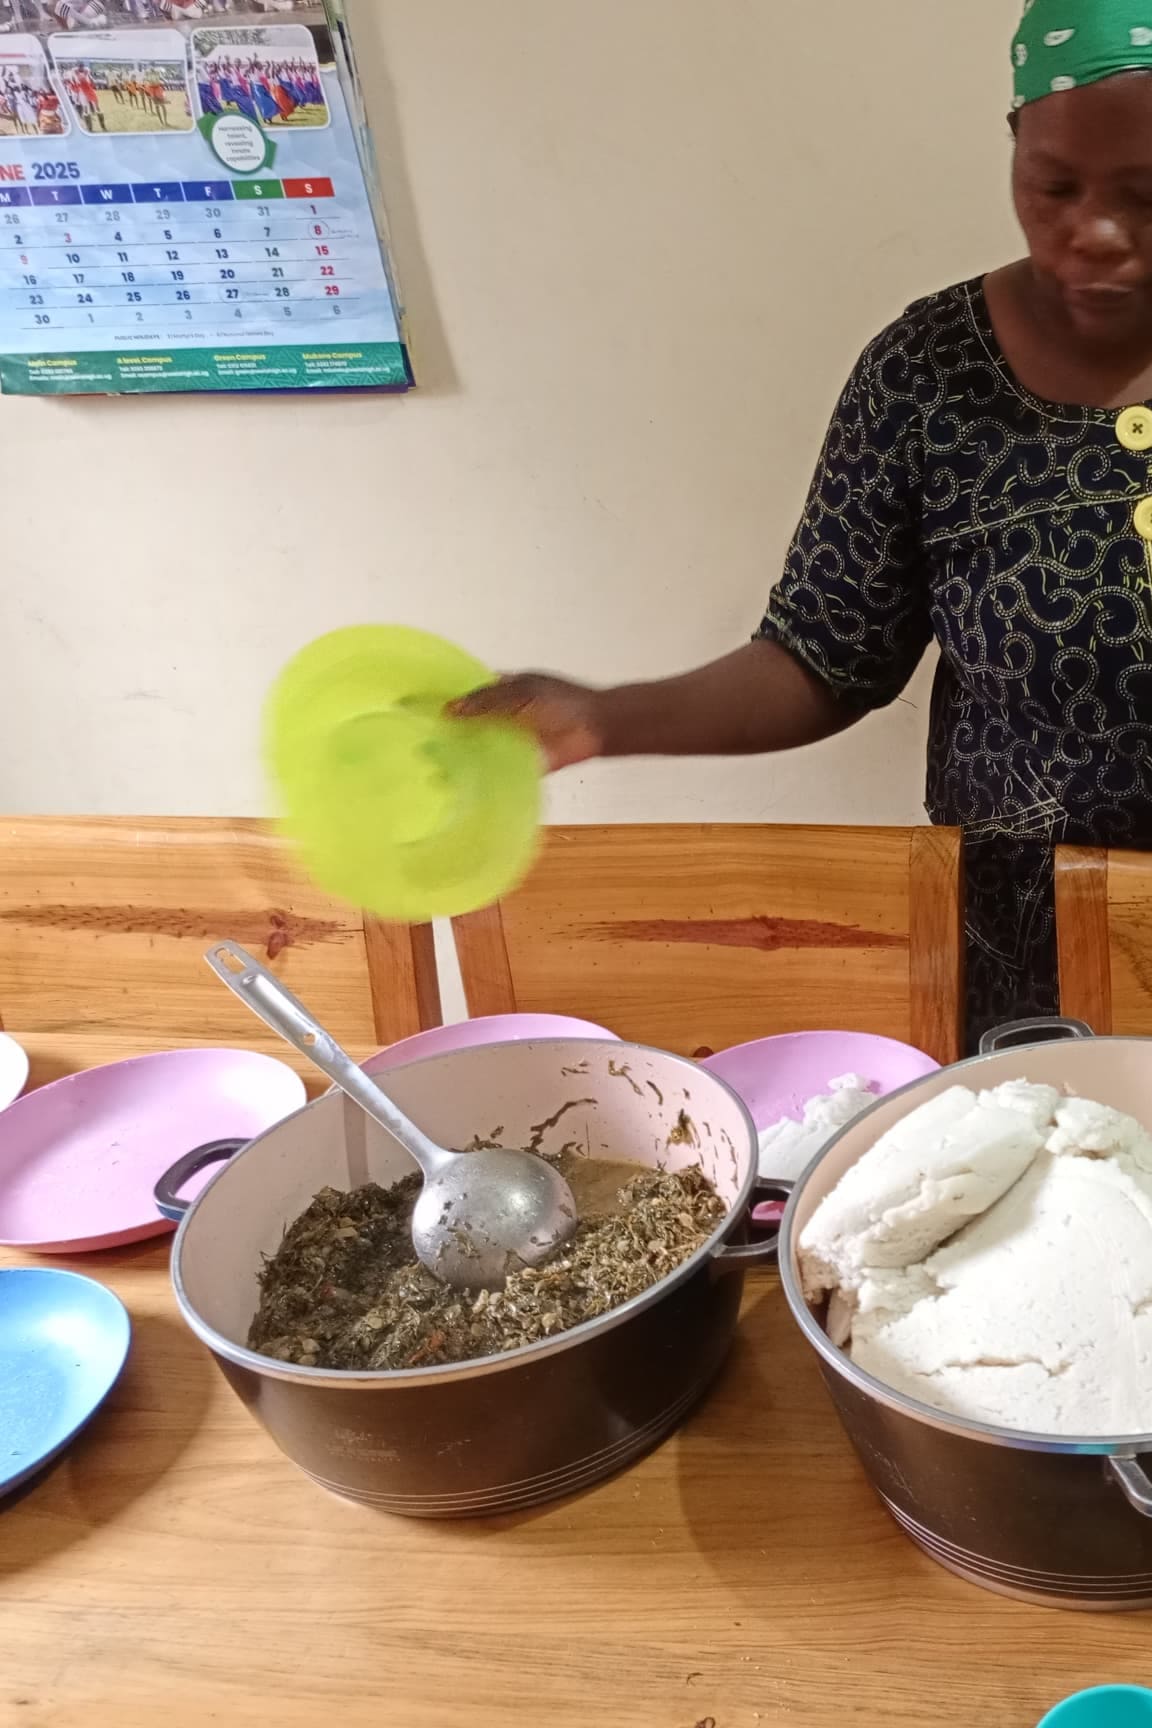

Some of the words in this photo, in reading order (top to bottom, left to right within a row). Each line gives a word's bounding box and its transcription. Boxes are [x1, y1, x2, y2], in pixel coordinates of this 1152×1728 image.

[32, 162, 81, 181] 2025
[51, 191, 59, 201] T
[100, 189, 113, 200] W
[153, 187, 161, 198] T
[204, 186, 212, 196] F
[253, 185, 262, 196] S
[304, 183, 313, 194] S
[4, 214, 20, 224] 26
[56, 212, 69, 223] 27
[105, 210, 120, 221] 28
[156, 209, 171, 220] 29
[205, 208, 221, 218] 30
[257, 206, 270, 217] 31
[310, 204, 317, 215] 1
[14, 234, 23, 245] 2
[64, 232, 72, 243] 3
[114, 231, 123, 242] 4
[164, 229, 173, 240] 5
[214, 228, 222, 239] 6
[263, 226, 271, 237] 7
[314, 225, 322, 236] 8
[66, 253, 80, 264] 10
[117, 251, 129, 262] 11
[166, 250, 180, 261] 12
[215, 248, 229, 259] 13
[265, 247, 280, 258] 14
[315, 245, 329, 256] 15
[23, 274, 37, 285] 16
[73, 273, 85, 284] 17
[121, 272, 136, 283] 18
[171, 270, 185, 281] 19
[220, 269, 235, 279] 20
[272, 267, 284, 278] 21
[320, 265, 335, 276] 22
[29, 294, 44, 305] 23
[77, 293, 94, 304] 24
[126, 291, 142, 302] 25
[176, 290, 191, 301] 26
[226, 288, 239, 299] 27
[274, 287, 290, 298] 28
[324, 285, 340, 296] 29
[34, 314, 51, 325] 30
[88, 313, 95, 324] 1
[136, 311, 144, 322] 2
[184, 309, 193, 320] 3
[234, 308, 242, 319] 4
[283, 306, 292, 317] 5
[333, 304, 341, 315] 6
[47, 359, 77, 367] Campus
[332, 352, 362, 360] Campus
